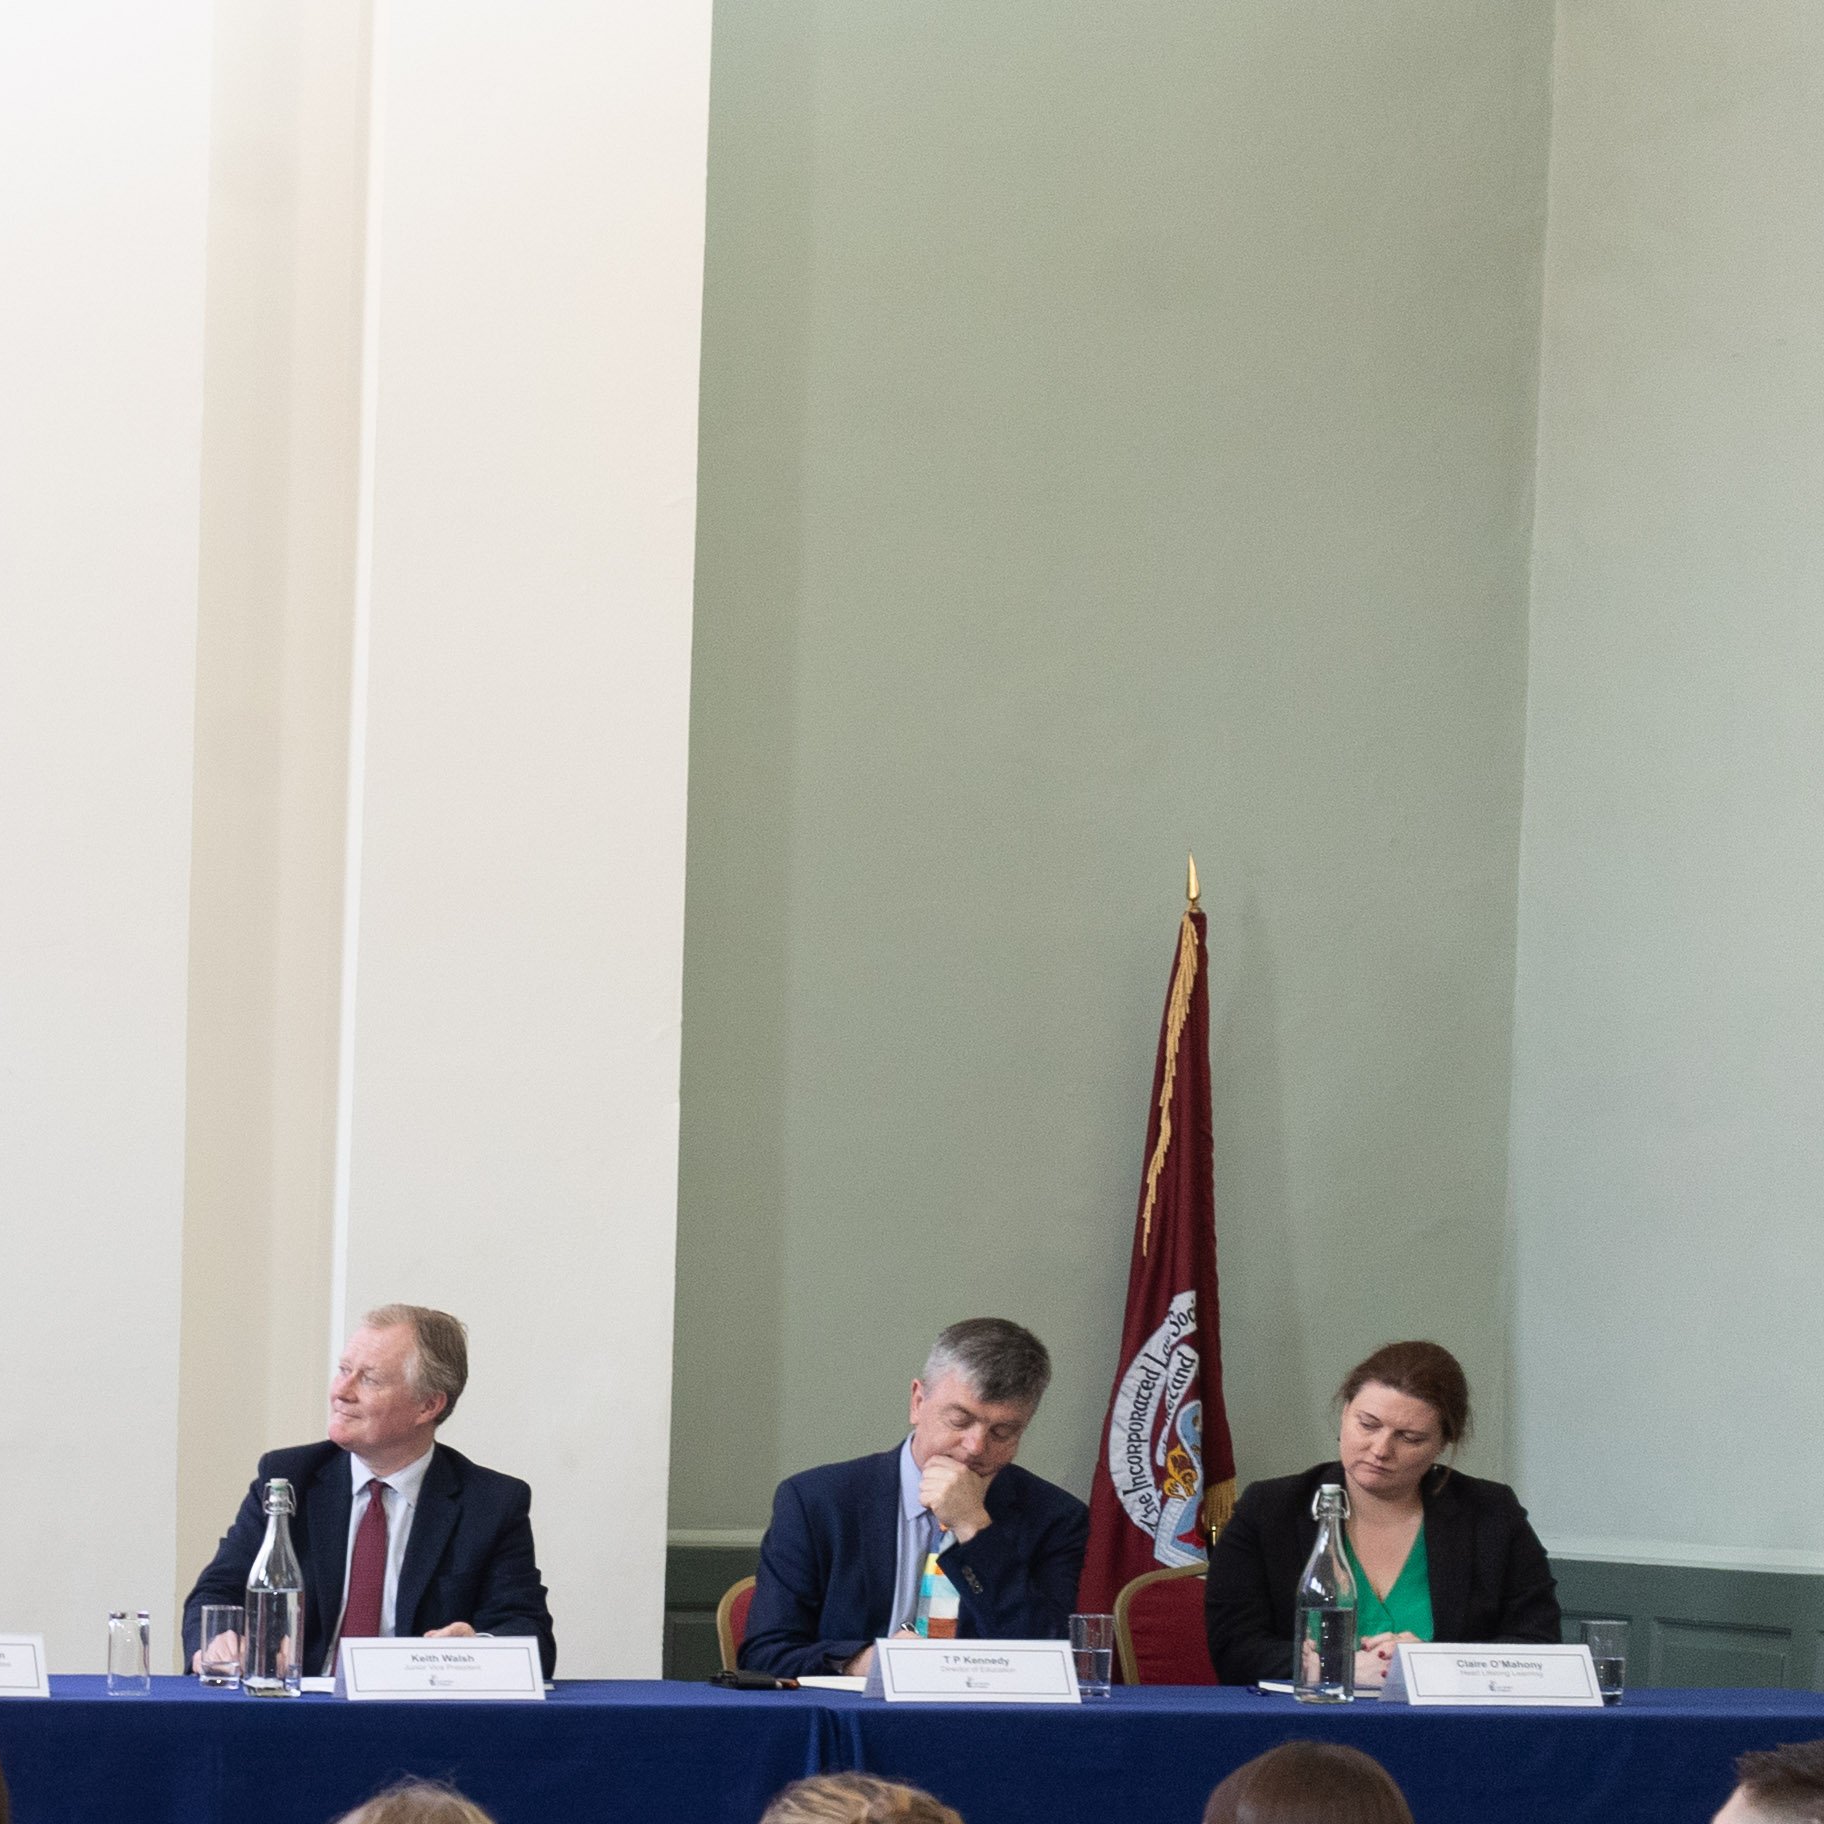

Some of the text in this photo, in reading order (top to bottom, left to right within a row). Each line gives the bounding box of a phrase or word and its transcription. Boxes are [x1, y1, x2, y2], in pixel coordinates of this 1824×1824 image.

[411, 1654, 475, 1662] Keith Walsh
[964, 1656, 1009, 1666] Kennedy
[1457, 1660, 1542, 1670] Claire O'Mahony
